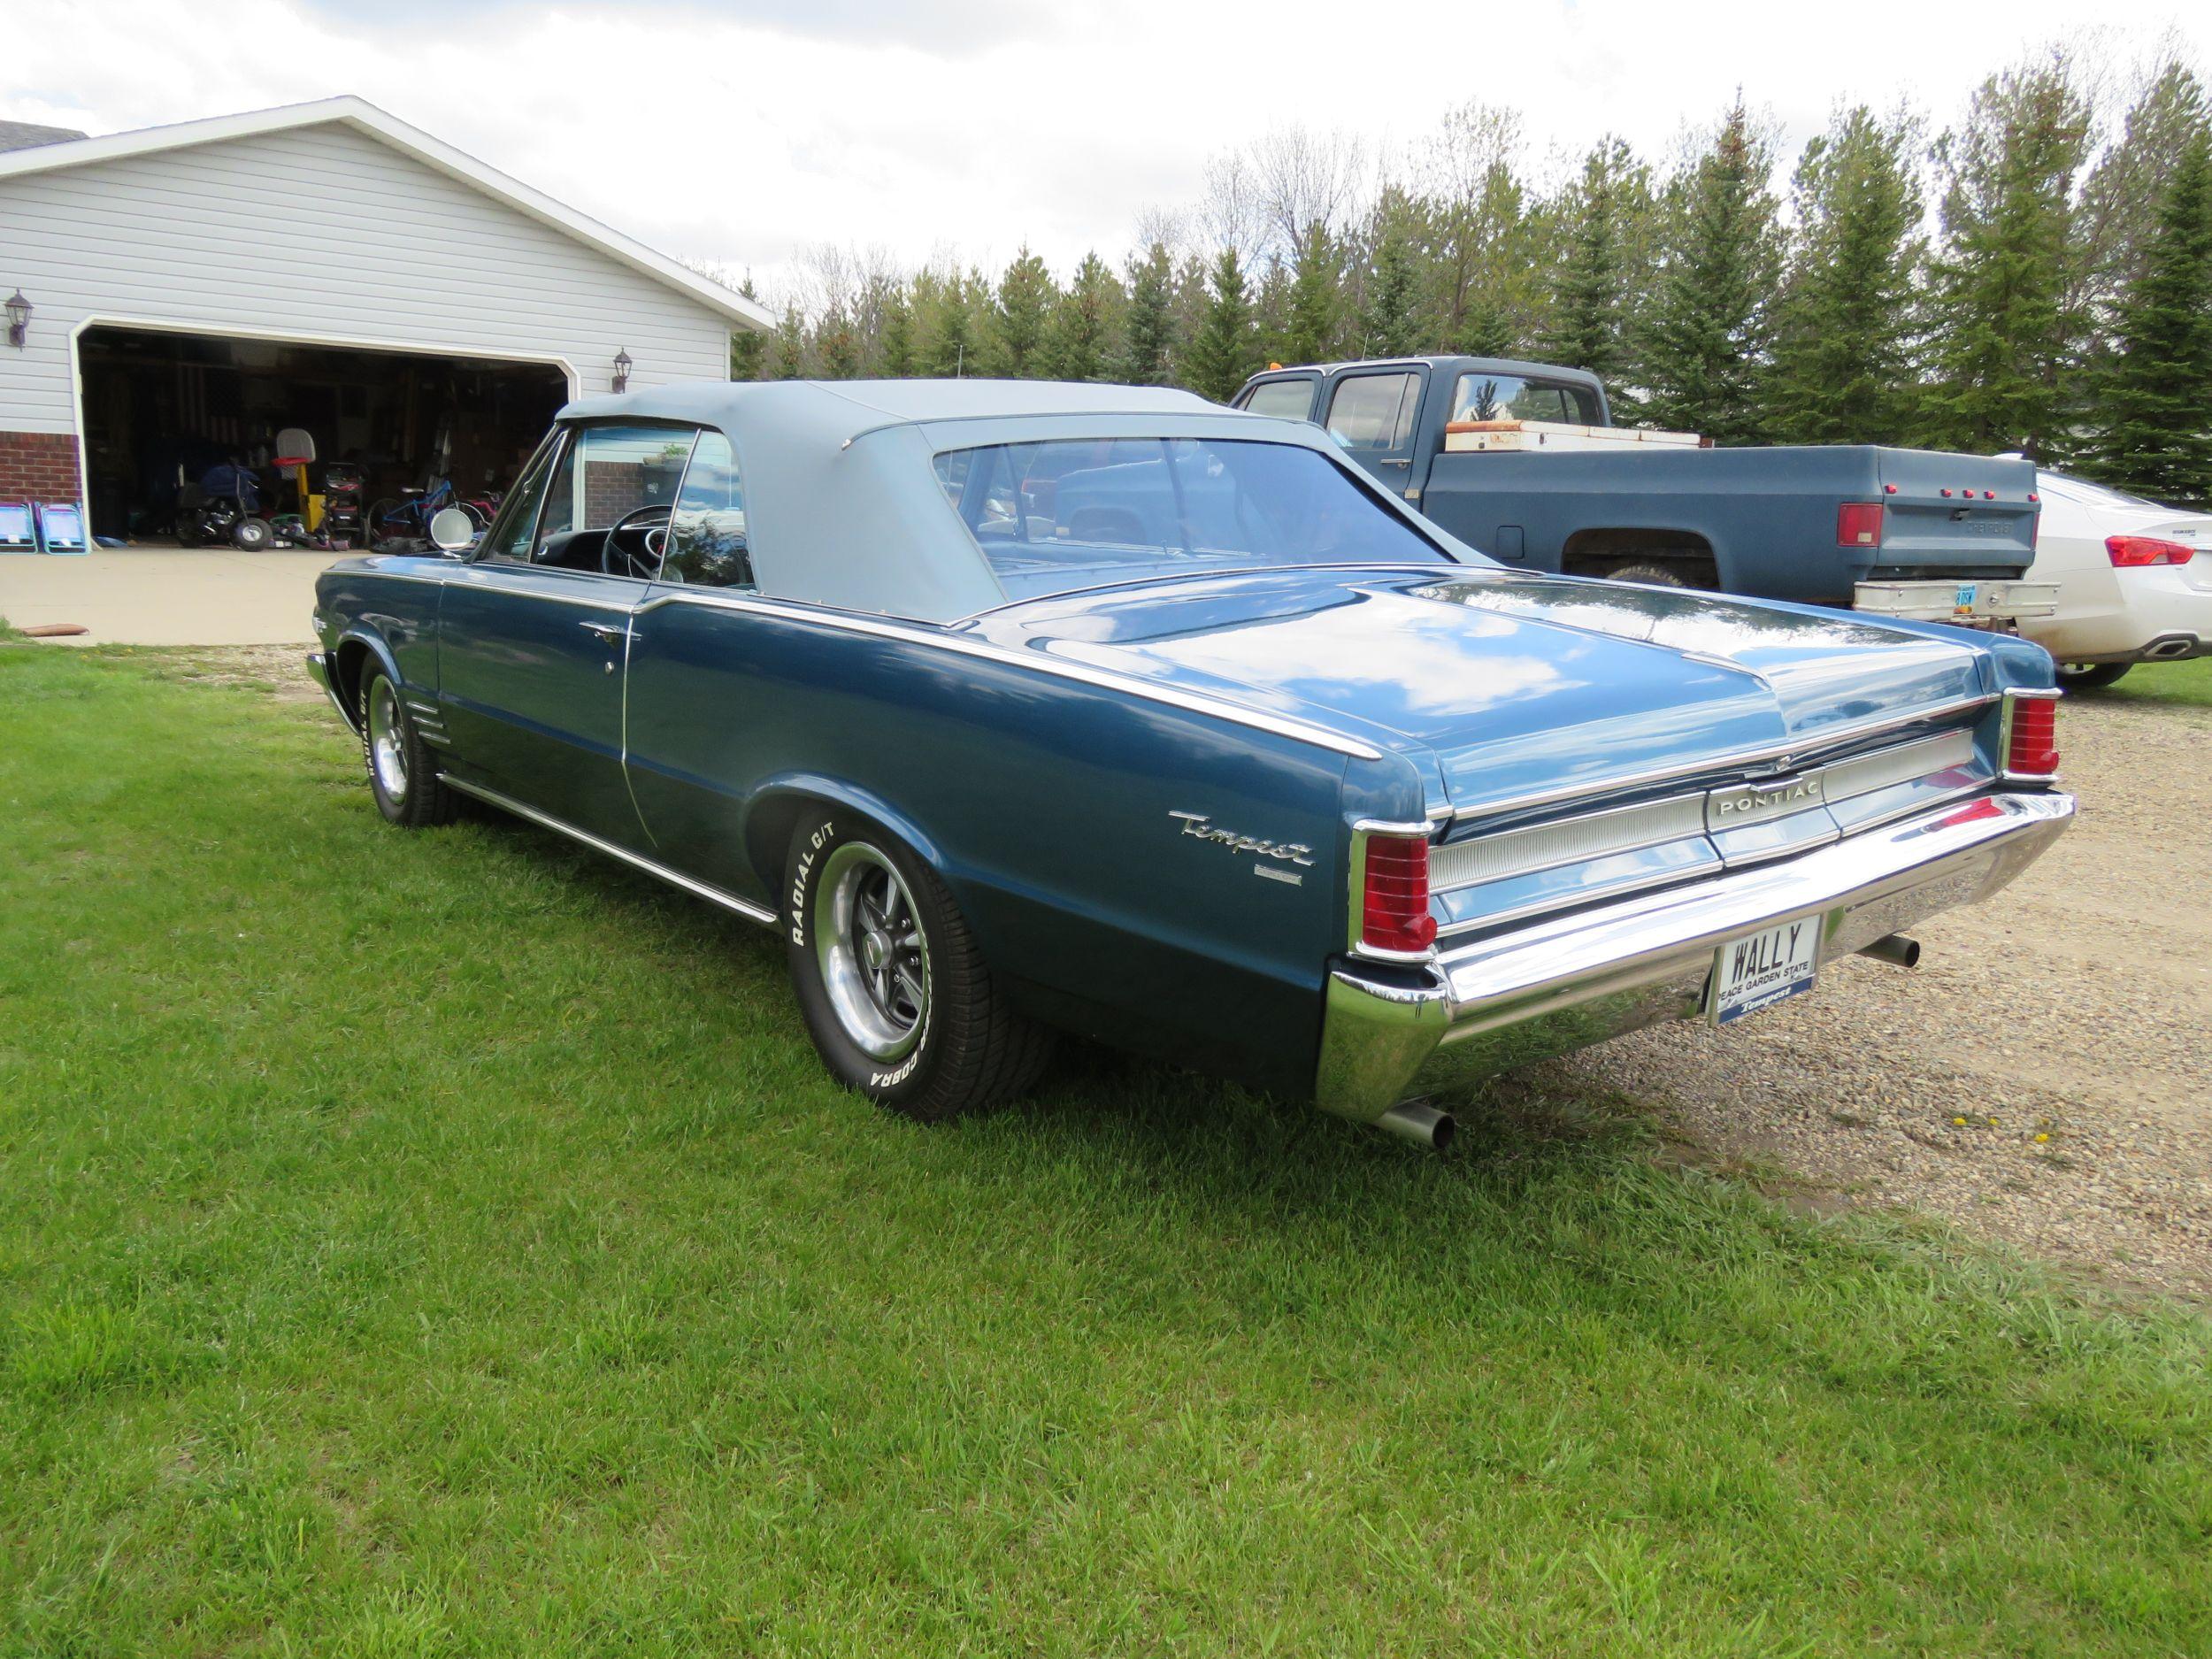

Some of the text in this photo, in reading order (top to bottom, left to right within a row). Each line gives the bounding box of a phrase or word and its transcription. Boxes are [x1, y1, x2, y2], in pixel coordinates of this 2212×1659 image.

[1719, 781, 1818, 816] PONTIAC
[1168, 810, 1317, 866] Tempest
[792, 821, 834, 947] RADIAL G/T
[1732, 922, 1802, 985] WALLY
[1746, 970, 1780, 991] GARDEN
[1784, 961, 1809, 977] STATE
[1740, 986, 1792, 1014] Tempest
[870, 1050, 918, 1087] COBRA
